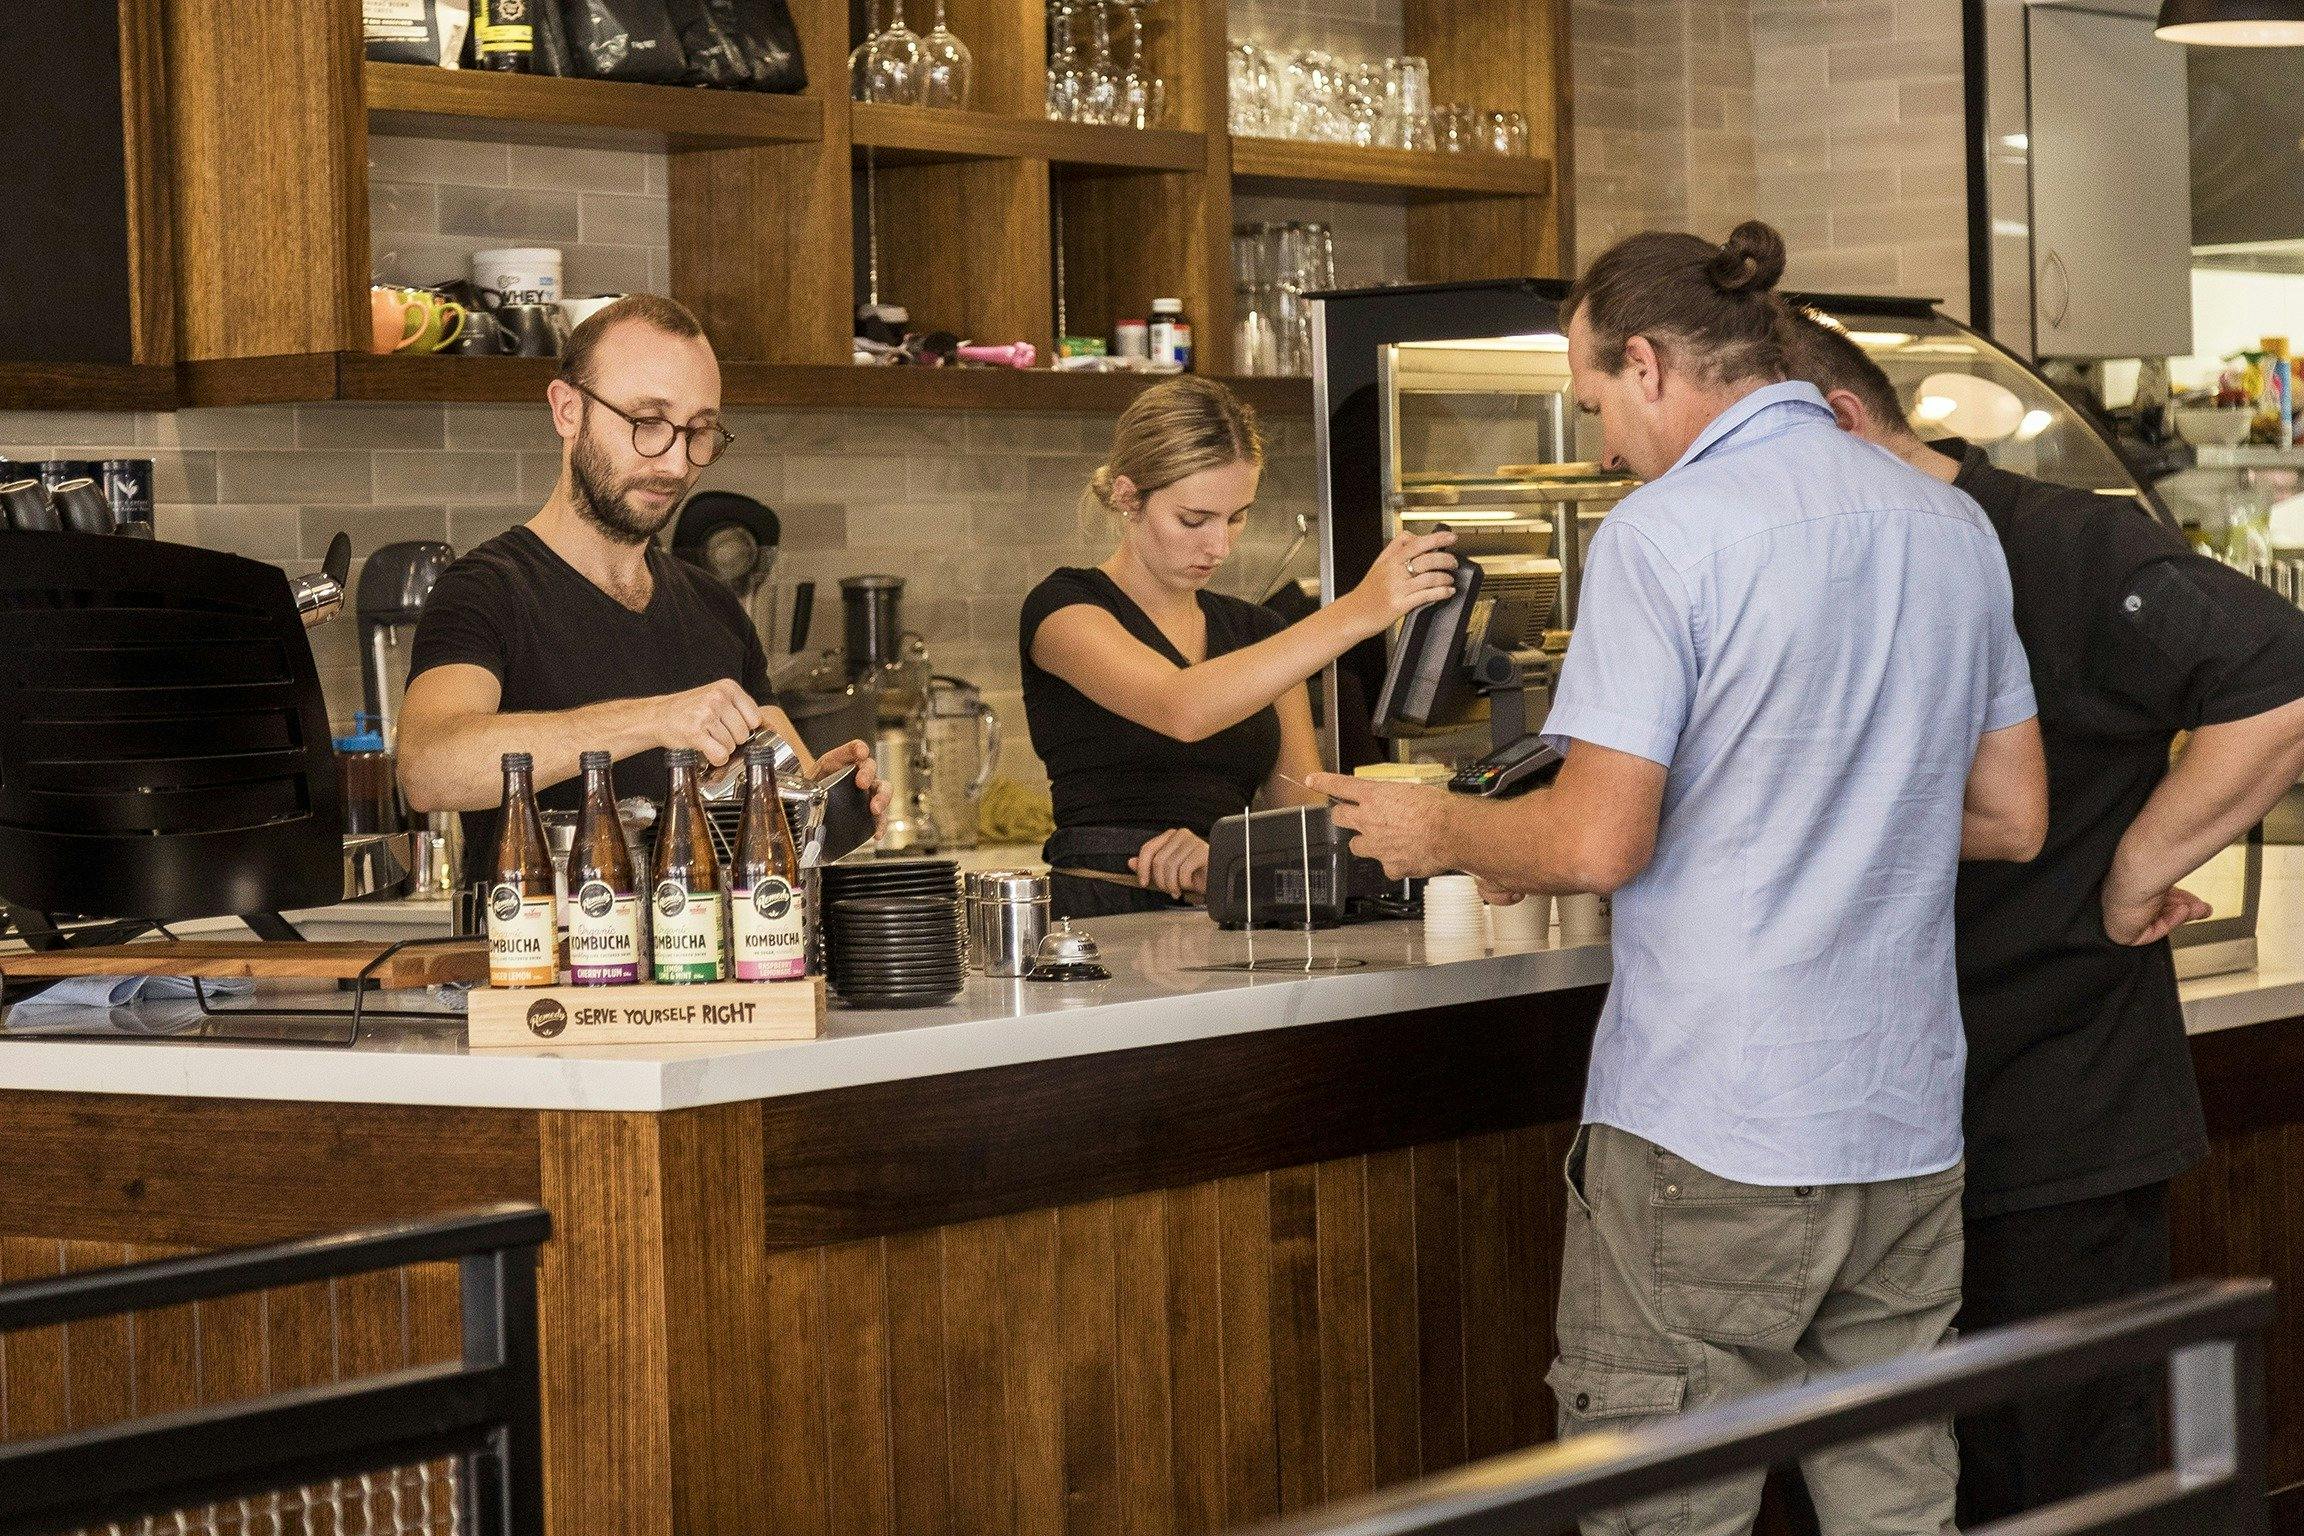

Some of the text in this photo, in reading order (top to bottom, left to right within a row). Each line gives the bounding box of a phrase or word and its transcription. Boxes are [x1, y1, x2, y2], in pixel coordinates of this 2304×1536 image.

[571, 934, 631, 950] KOMBUCHA
[654, 934, 706, 950] OMBUCHA
[745, 932, 800, 948] KOMBUCHA
[577, 968, 602, 979] CHERRY
[602, 967, 623, 978] PLUM
[529, 1008, 565, 1030] Remedy
[574, 1002, 756, 1026] SERVE YOURSELF RIGHT
